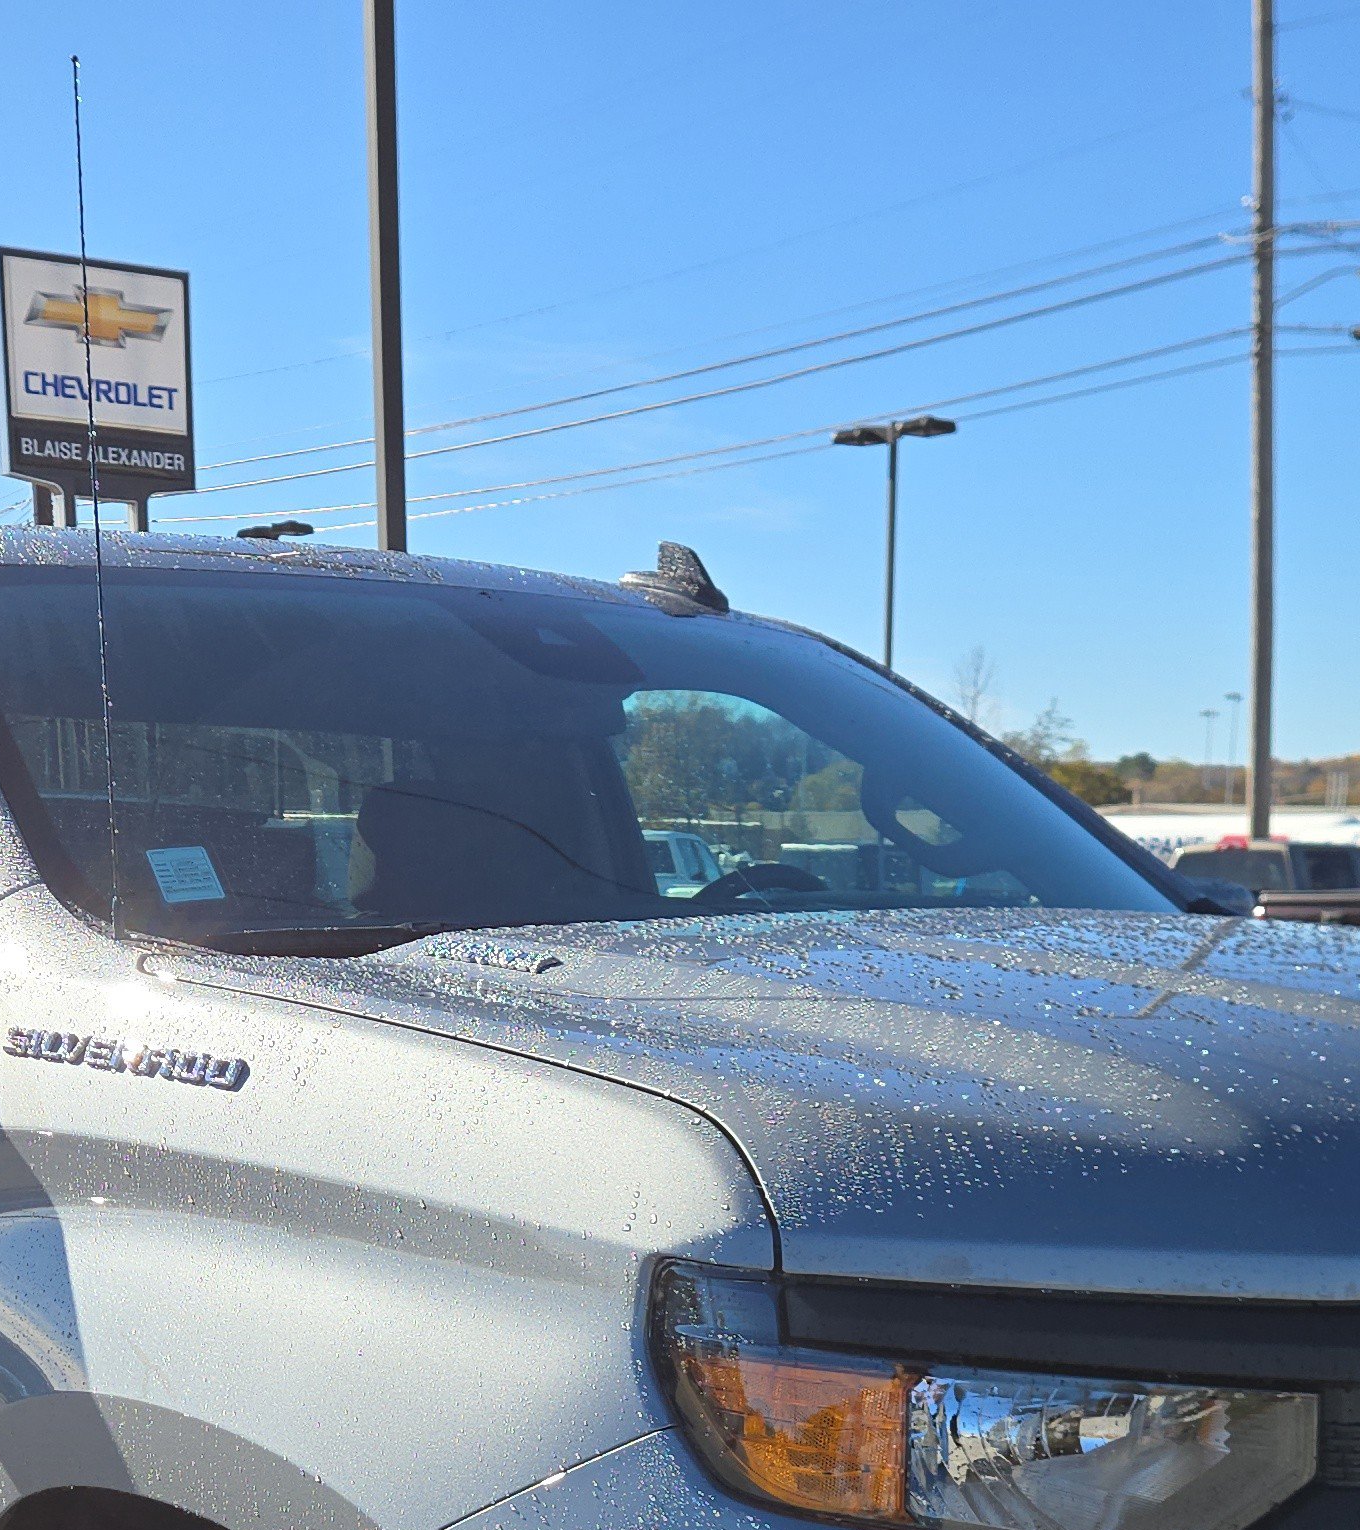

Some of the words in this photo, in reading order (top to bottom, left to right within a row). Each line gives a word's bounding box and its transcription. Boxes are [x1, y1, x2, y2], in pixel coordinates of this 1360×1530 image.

[23, 370, 178, 410] CHEVROLET
[21, 437, 82, 460] BLAISE
[86, 446, 185, 471] ALEXANDER
